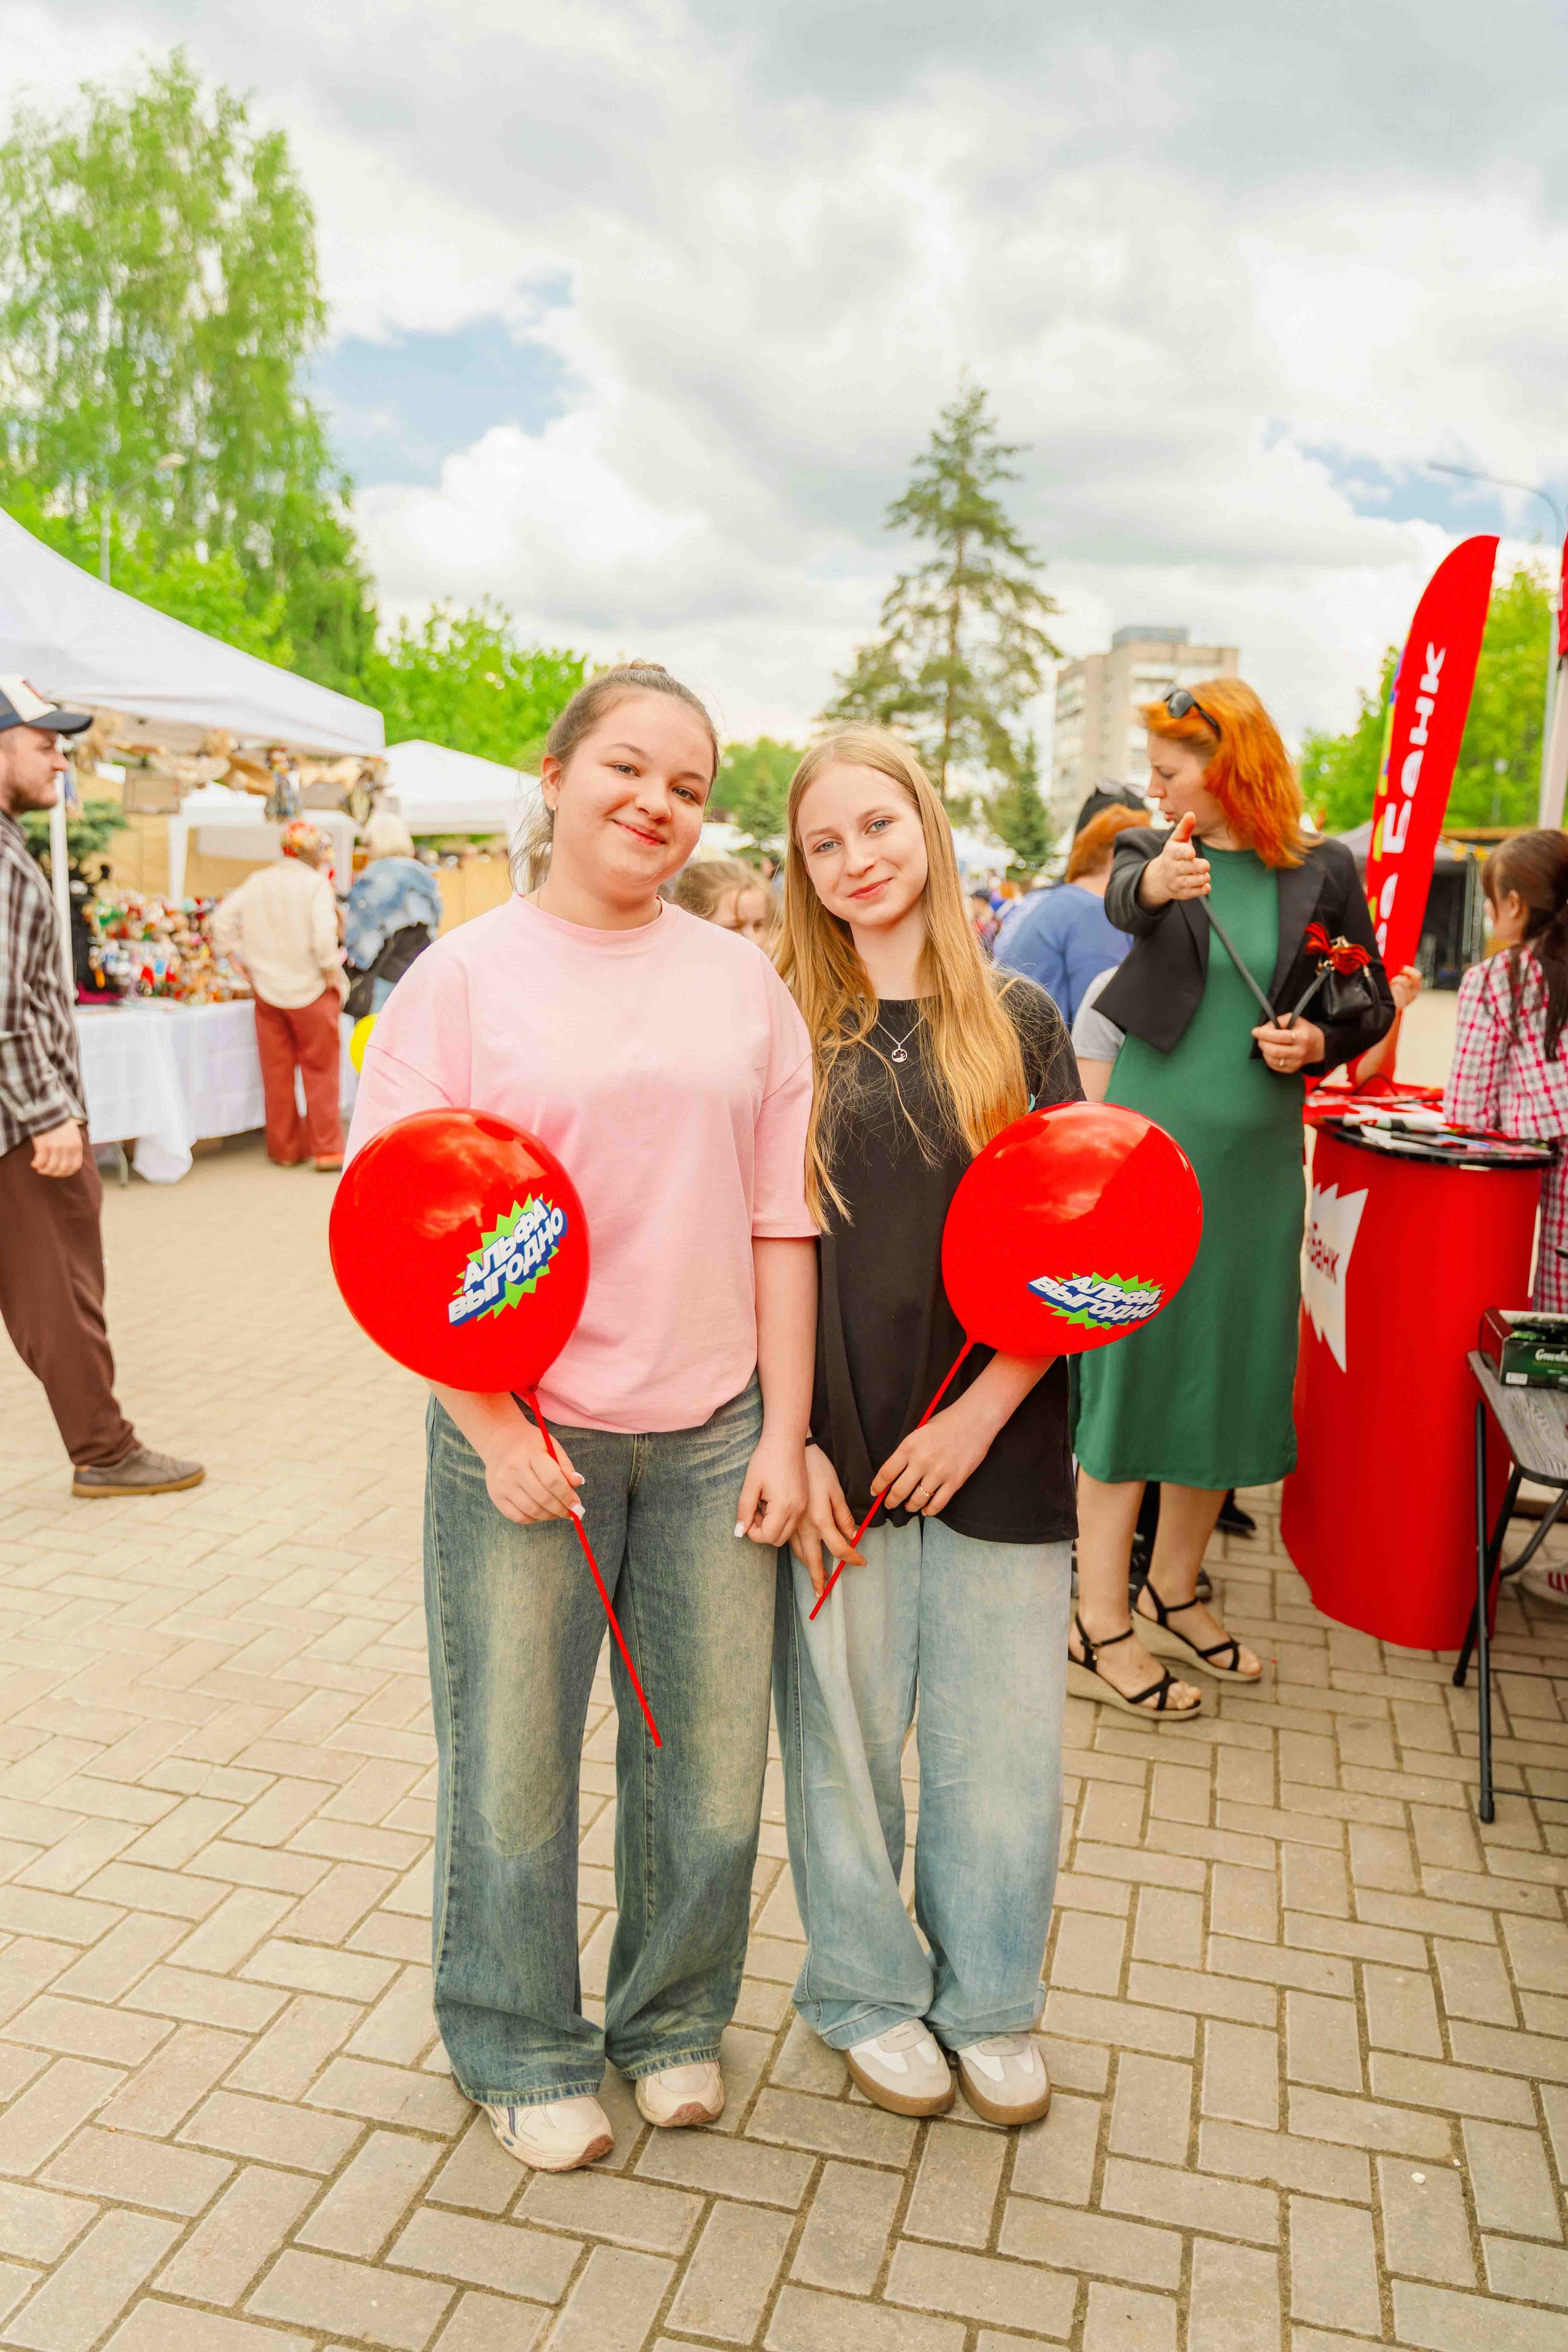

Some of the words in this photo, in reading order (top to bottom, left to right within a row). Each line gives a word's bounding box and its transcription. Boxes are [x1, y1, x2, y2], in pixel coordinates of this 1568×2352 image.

[448, 1207, 565, 1325] ВЫГОДНО
[462, 1198, 548, 1292] АЛЬФА
[1028, 1276, 1160, 1321] ВЫГОДНО
[1063, 1276, 1163, 1305] АЛЬФА
